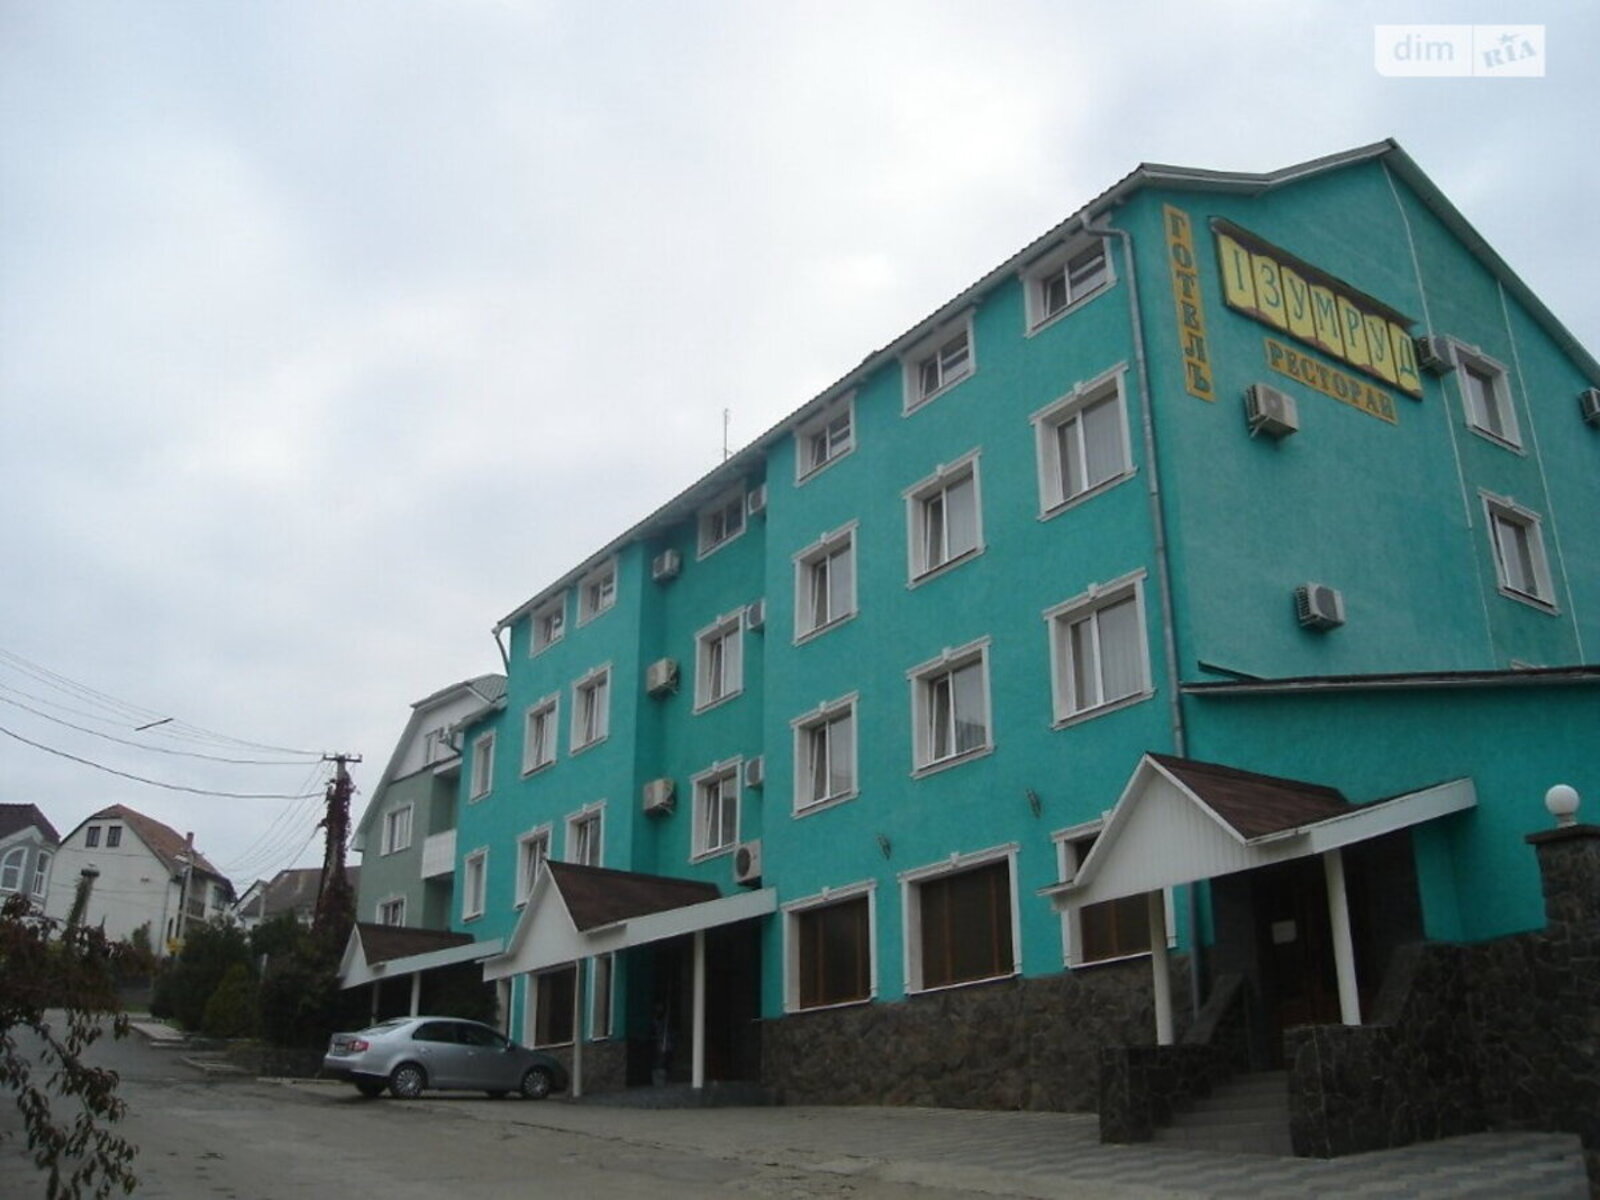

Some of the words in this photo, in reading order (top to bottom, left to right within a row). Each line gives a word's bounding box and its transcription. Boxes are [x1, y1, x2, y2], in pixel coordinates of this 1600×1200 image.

[1170, 212, 1212, 394] ГОТЕЛЬ
[1234, 249, 1417, 379] ІЗУМРУД
[1267, 339, 1396, 421] РЕСТОРАН
